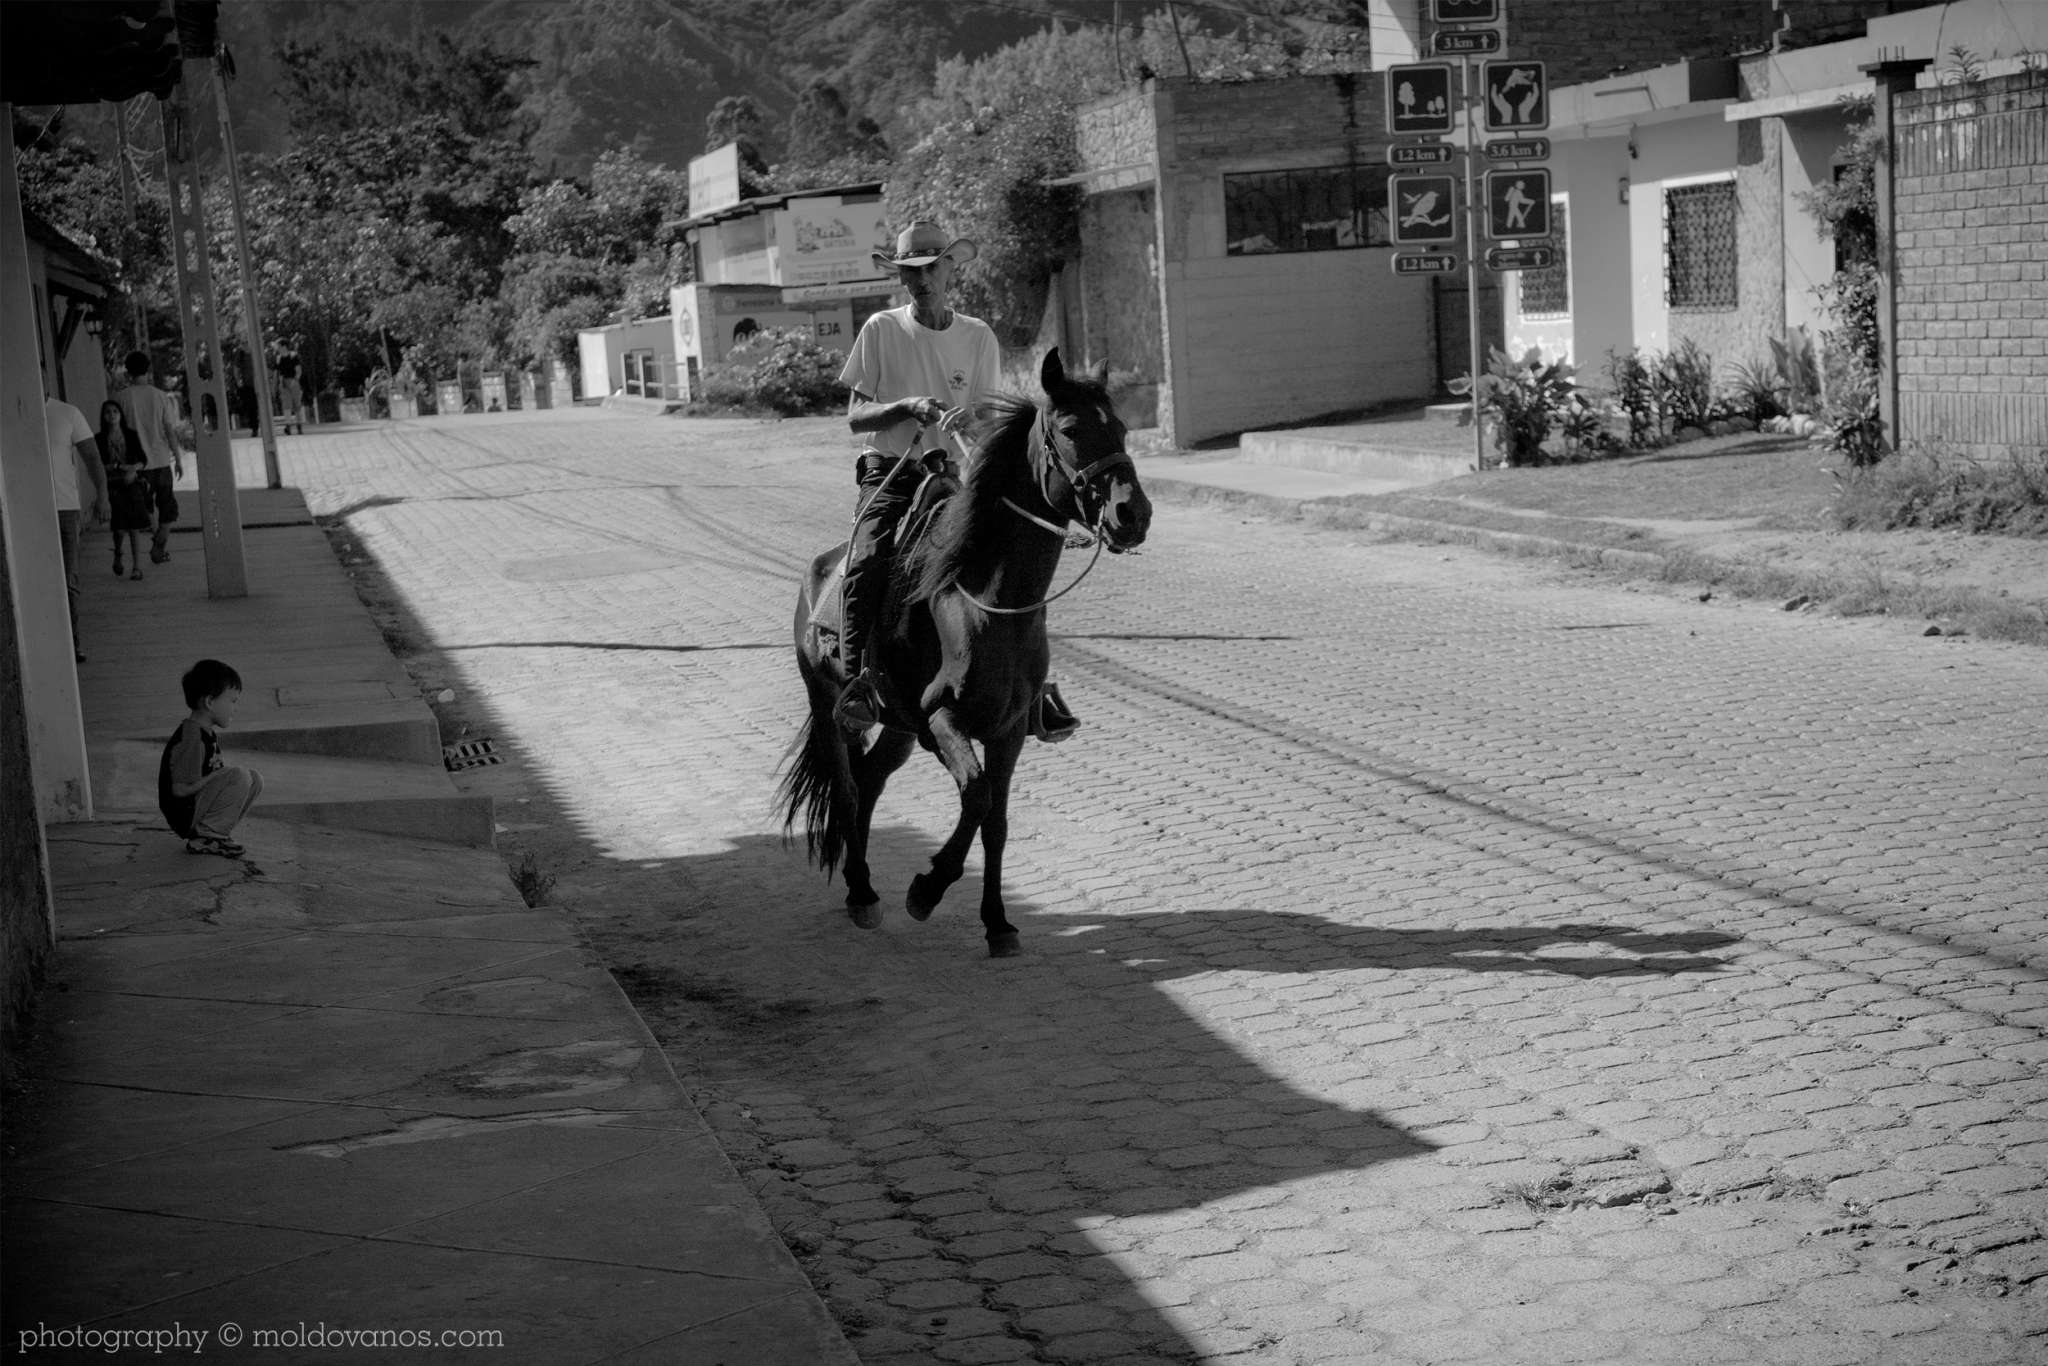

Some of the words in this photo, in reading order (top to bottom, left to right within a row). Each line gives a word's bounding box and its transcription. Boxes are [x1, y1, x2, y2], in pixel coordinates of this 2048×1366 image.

[1444, 37, 1451, 49] 3
[1454, 37, 1473, 48] km
[1416, 149, 1436, 160] km
[1491, 144, 1509, 157] 3.6
[1511, 144, 1532, 156] km
[1420, 258, 1440, 269] km
